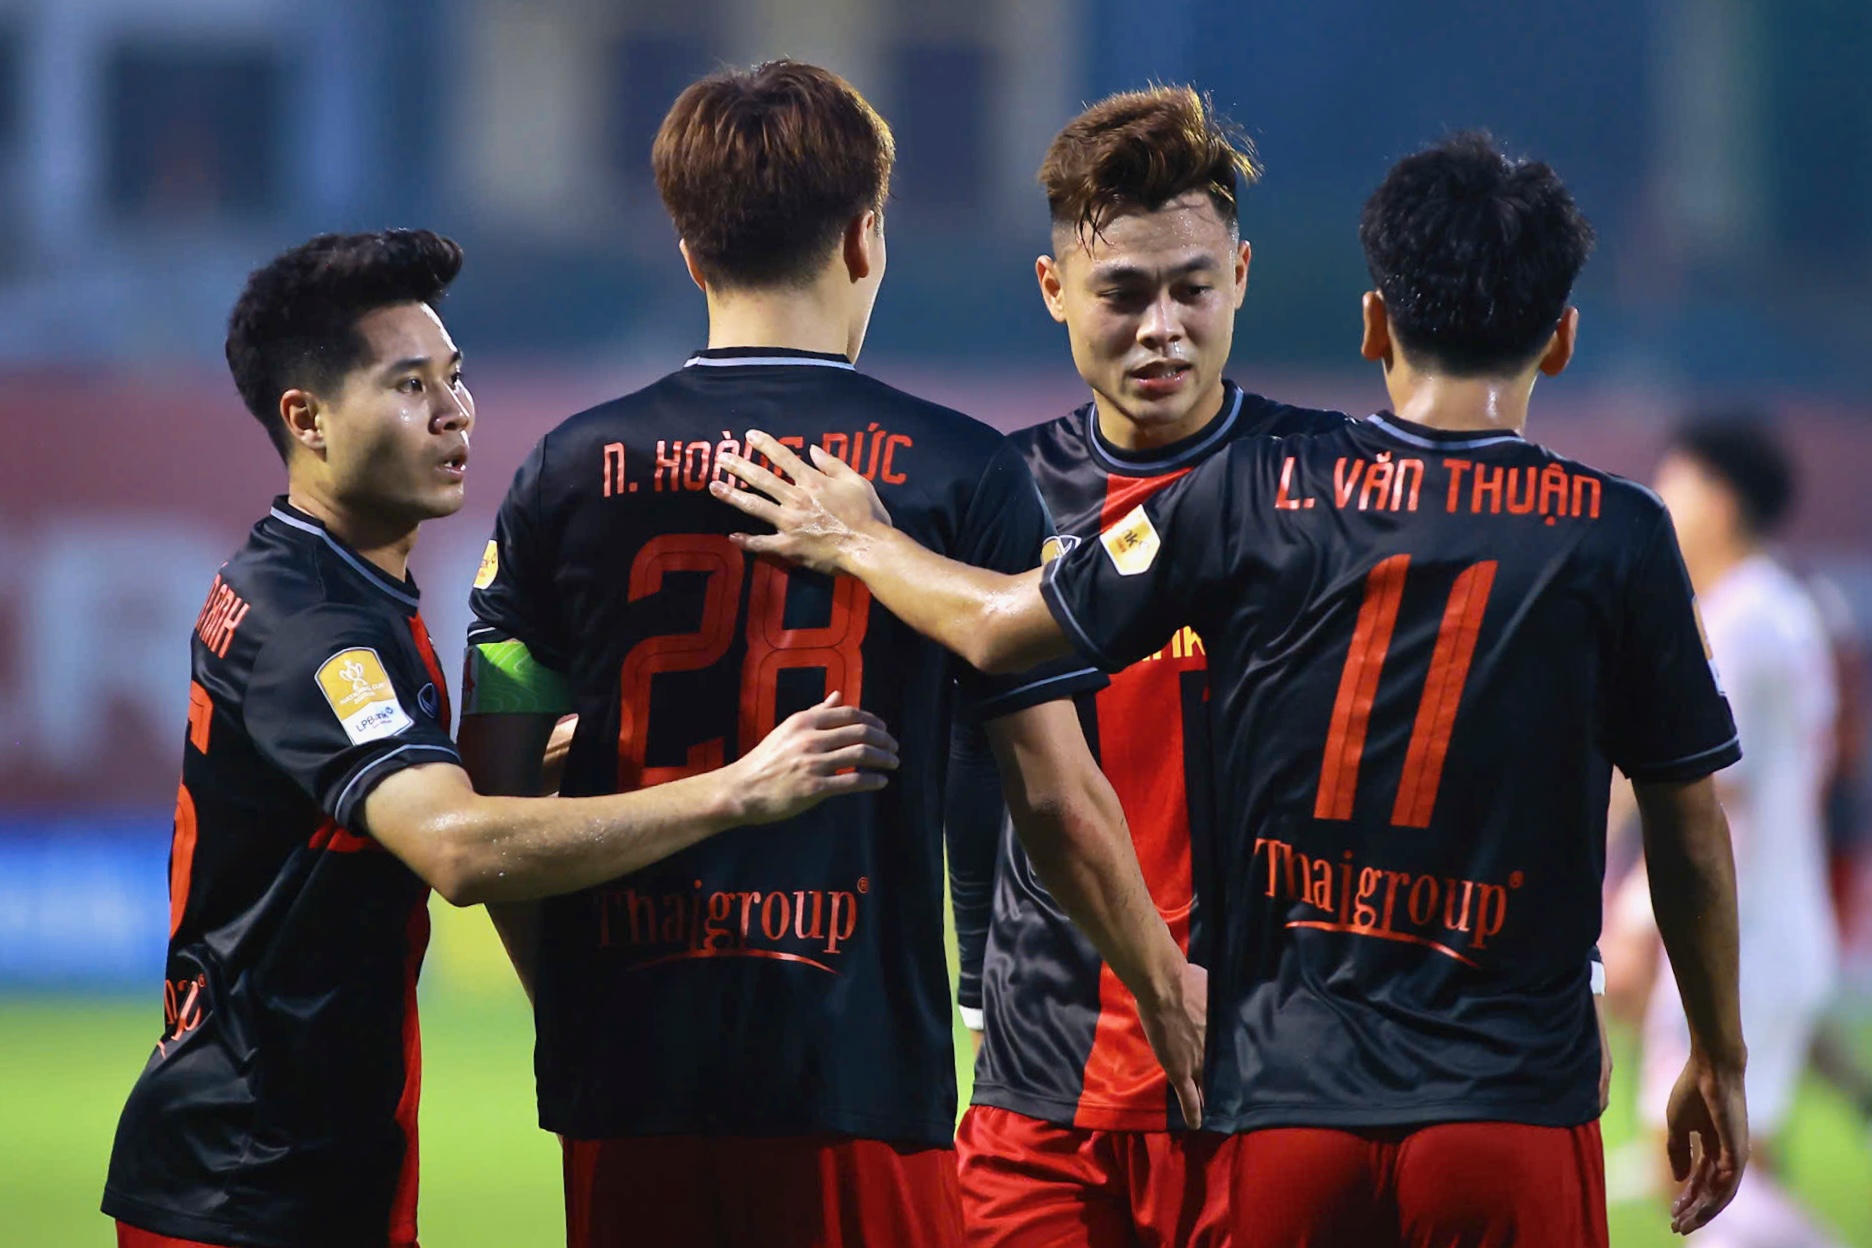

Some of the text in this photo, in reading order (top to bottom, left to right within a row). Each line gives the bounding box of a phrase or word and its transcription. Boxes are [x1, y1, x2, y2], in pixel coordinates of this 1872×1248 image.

[1275, 451, 1600, 526] L. VĂN THUẬN
[618, 533, 872, 793] 28
[1313, 553, 1499, 828] 11
